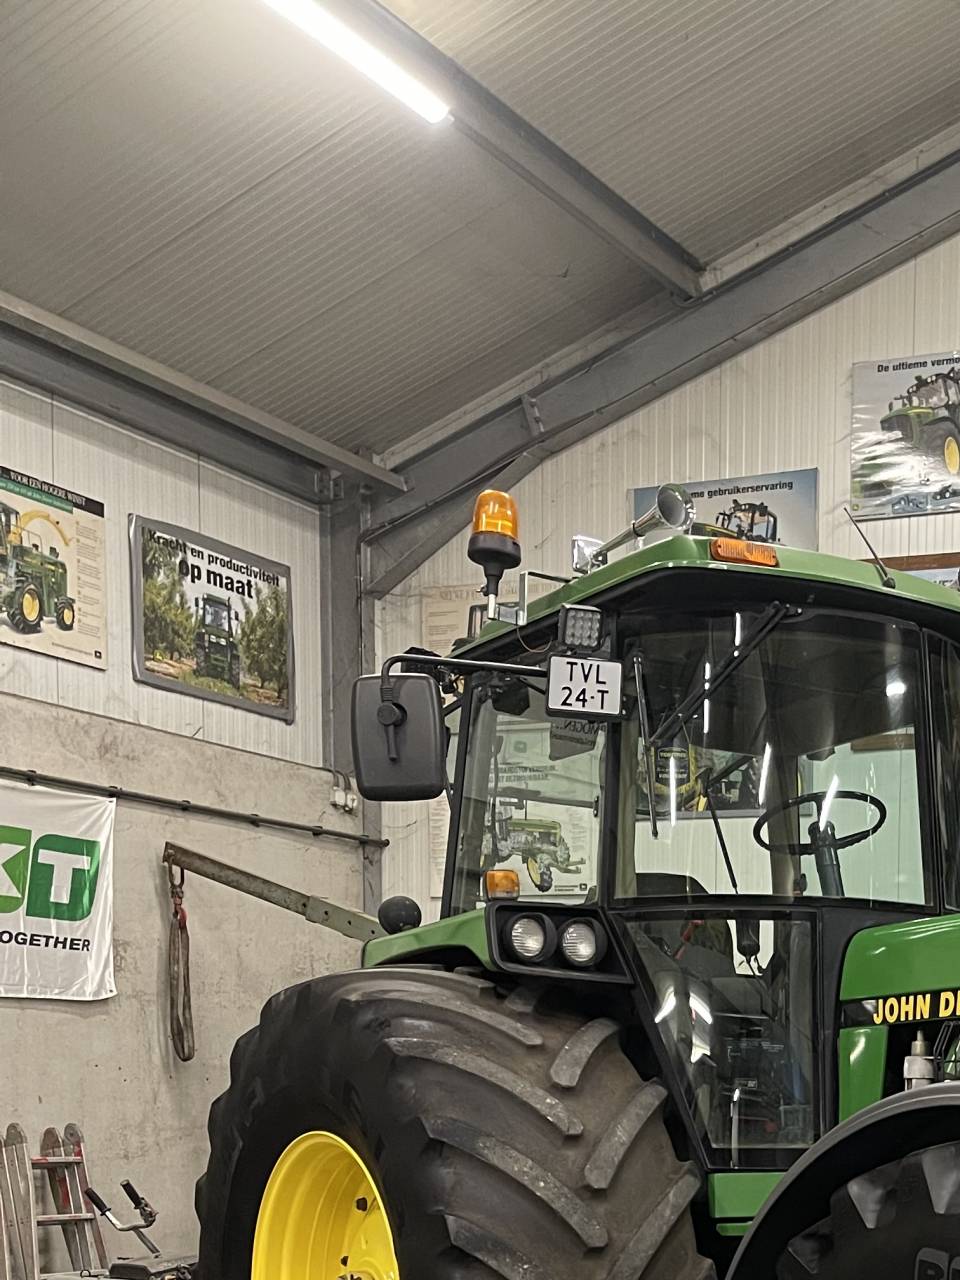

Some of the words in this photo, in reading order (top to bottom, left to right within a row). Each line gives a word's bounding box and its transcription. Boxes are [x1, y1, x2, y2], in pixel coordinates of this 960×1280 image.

[877, 364, 890, 373] De
[892, 359, 928, 371] ultieme
[707, 481, 794, 499] gebruikerservaring
[150, 530, 188, 555] Kracht
[190, 547, 204, 560] en
[207, 553, 280, 587] productiviteit
[178, 560, 201, 584] op
[206, 568, 254, 599] maat
[566, 662, 607, 686] TVL
[561, 686, 609, 710] 24-T
[0, 931, 91, 952] OGETHER
[873, 994, 930, 1024] JOHN
